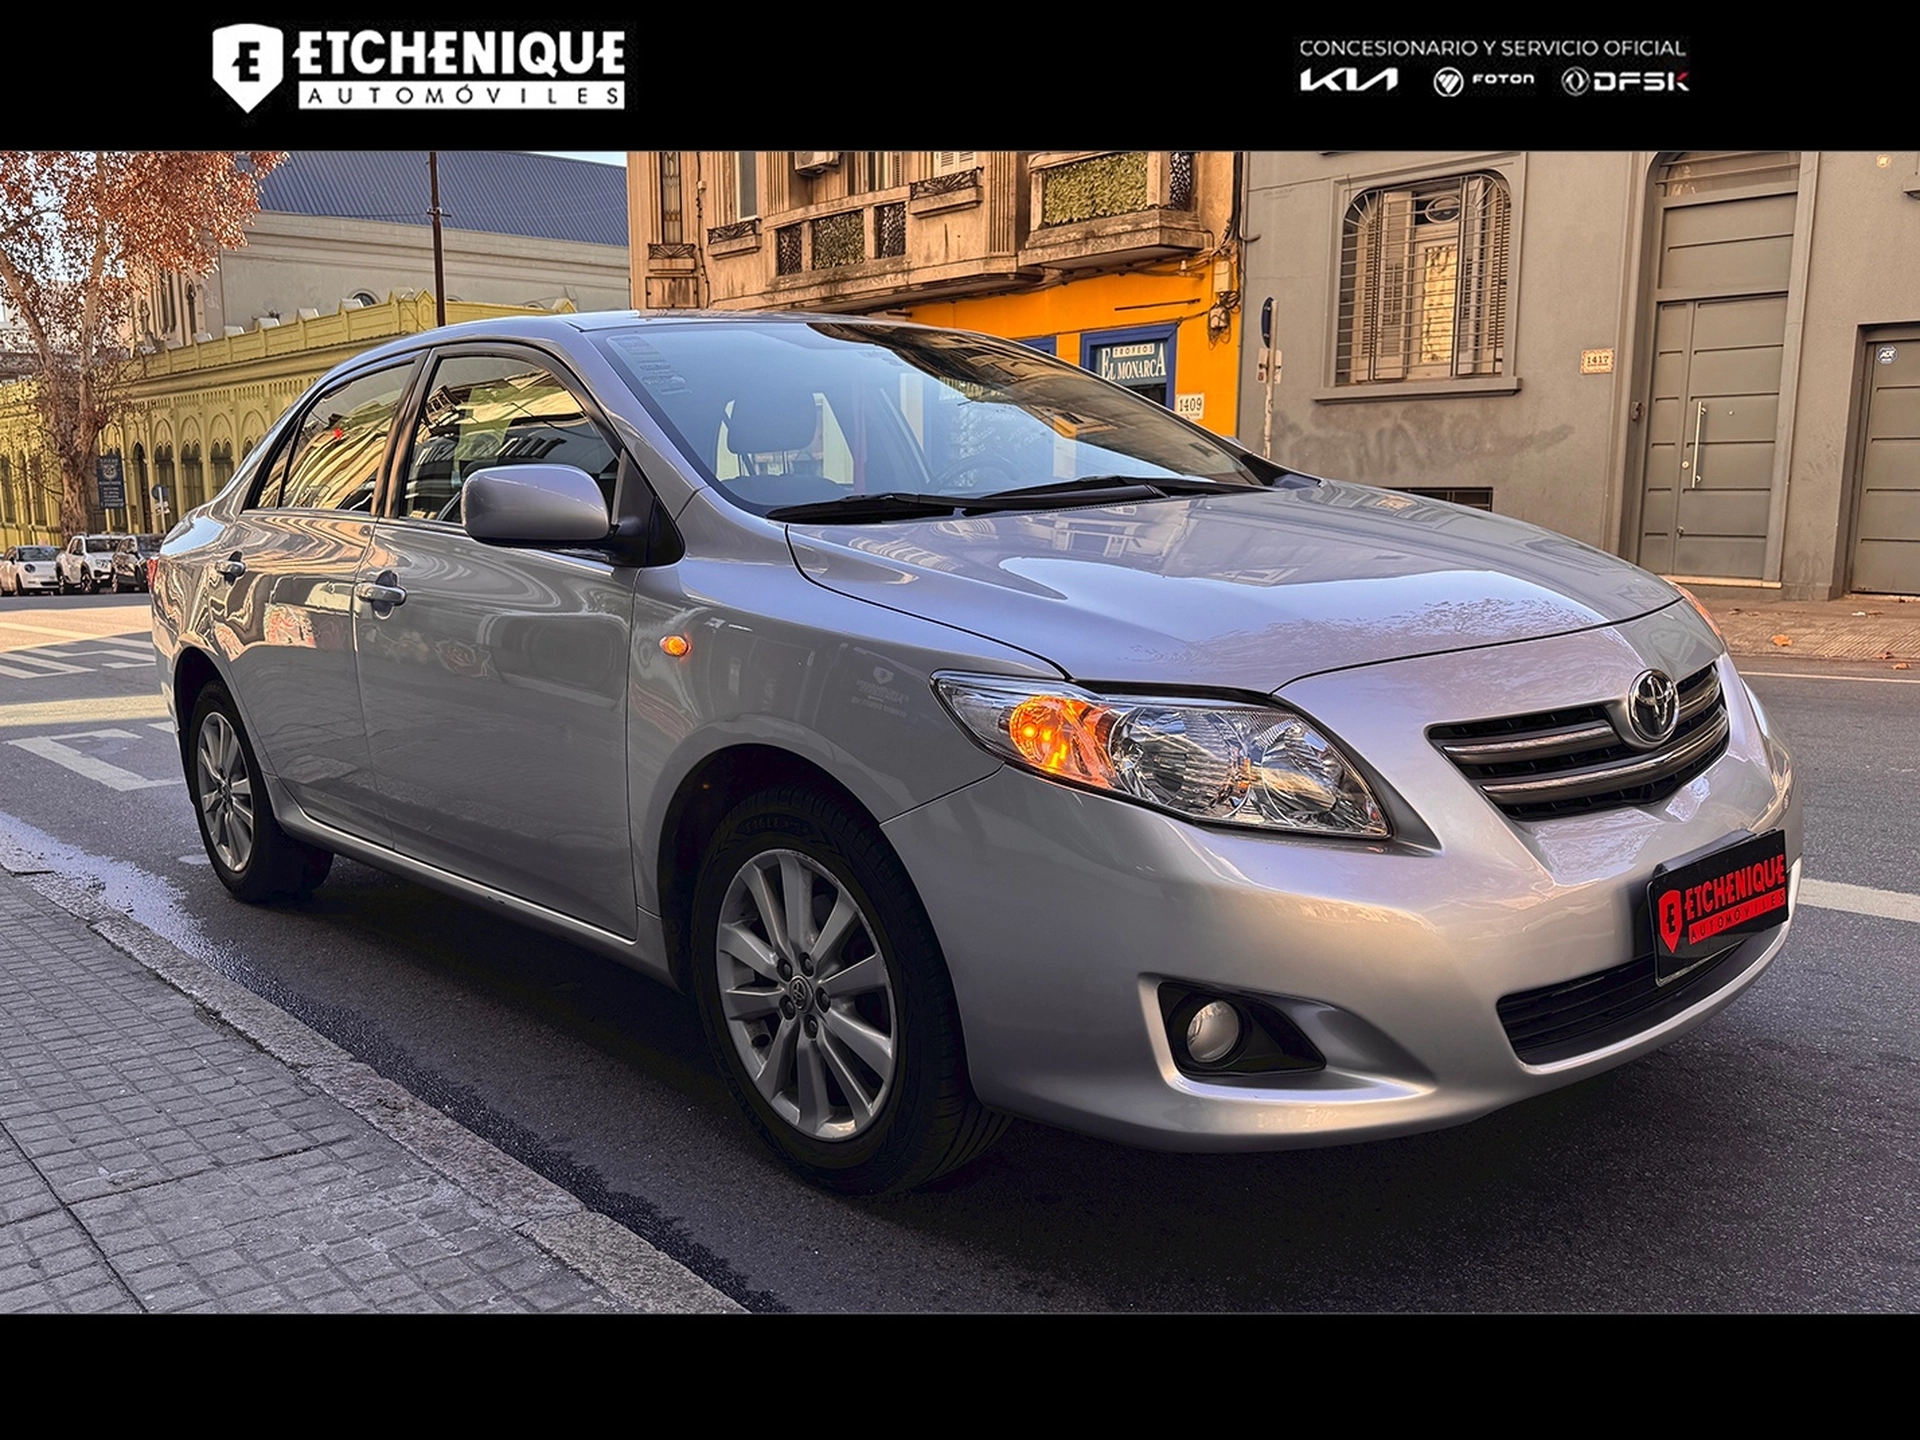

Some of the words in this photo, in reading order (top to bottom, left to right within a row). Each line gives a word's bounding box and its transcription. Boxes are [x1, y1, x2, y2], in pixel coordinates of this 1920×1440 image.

[1101, 347, 1117, 380] EL
[1117, 343, 1167, 379] MONARCA
[1114, 344, 1154, 356] TROFEOS
[1587, 355, 1609, 364] 1417
[1179, 397, 1203, 412] 1409
[1684, 854, 1786, 920] ETCHENIQUE
[1691, 890, 1785, 940] AUTOMÓVILES
